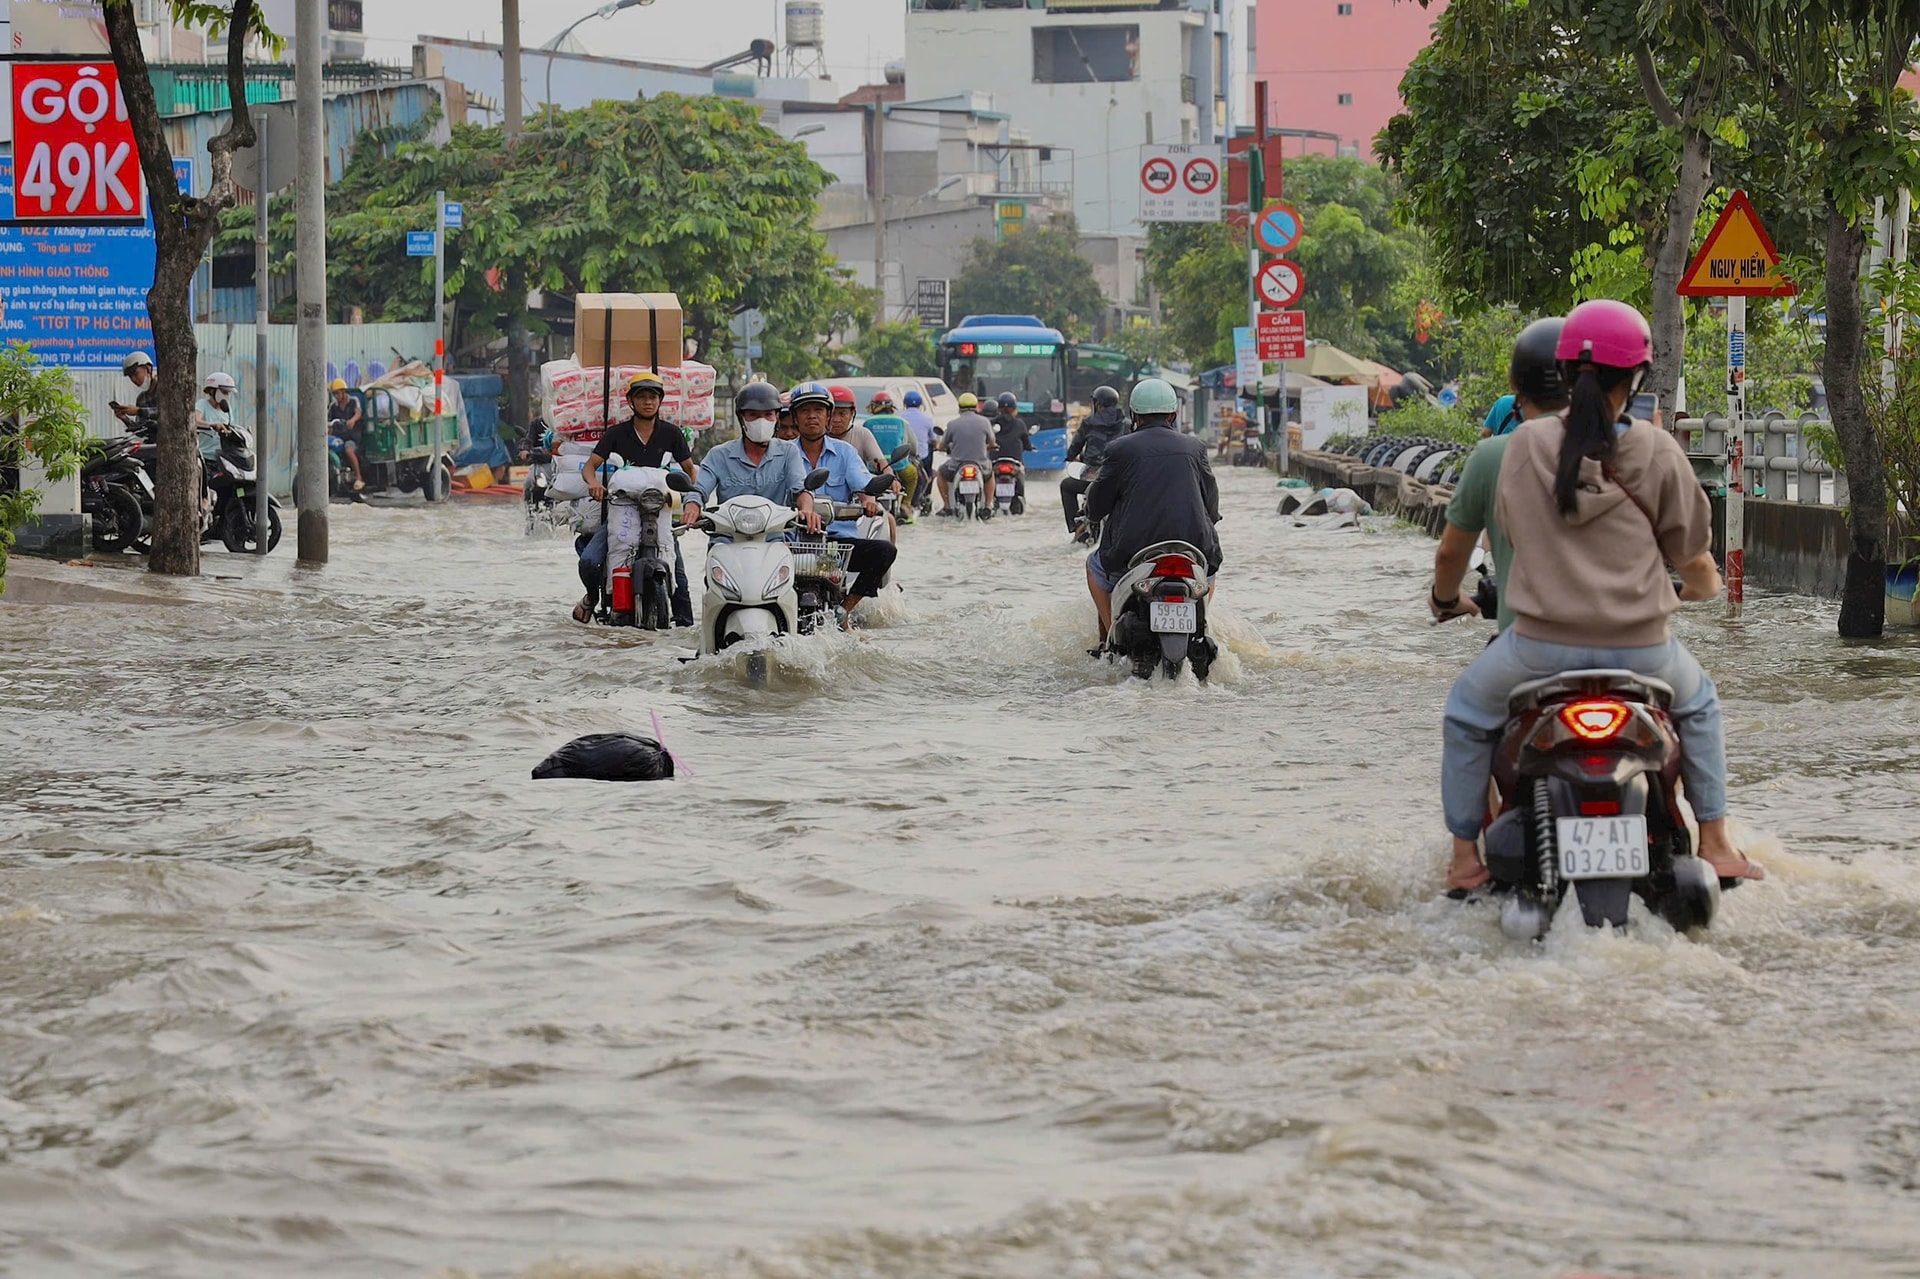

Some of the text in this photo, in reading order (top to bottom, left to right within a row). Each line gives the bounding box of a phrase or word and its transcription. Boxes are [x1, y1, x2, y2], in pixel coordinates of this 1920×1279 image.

[1168, 144, 1192, 154] ZONE
[20, 141, 134, 213] 49K
[18, 262, 44, 277] HÌNH
[47, 266, 71, 277] GIAO
[74, 264, 109, 277] THÔNG
[1710, 251, 1765, 278] NGUY HIỂM
[13, 285, 30, 297] giao
[59, 285, 77, 295] theo
[919, 281, 944, 294] HOTEL
[73, 315, 90, 330] TP
[1271, 313, 1290, 325] CẤM
[1157, 604, 1189, 617] 59-C2
[1573, 821, 1630, 845] 47-AT
[1565, 847, 1642, 873] 032.66
